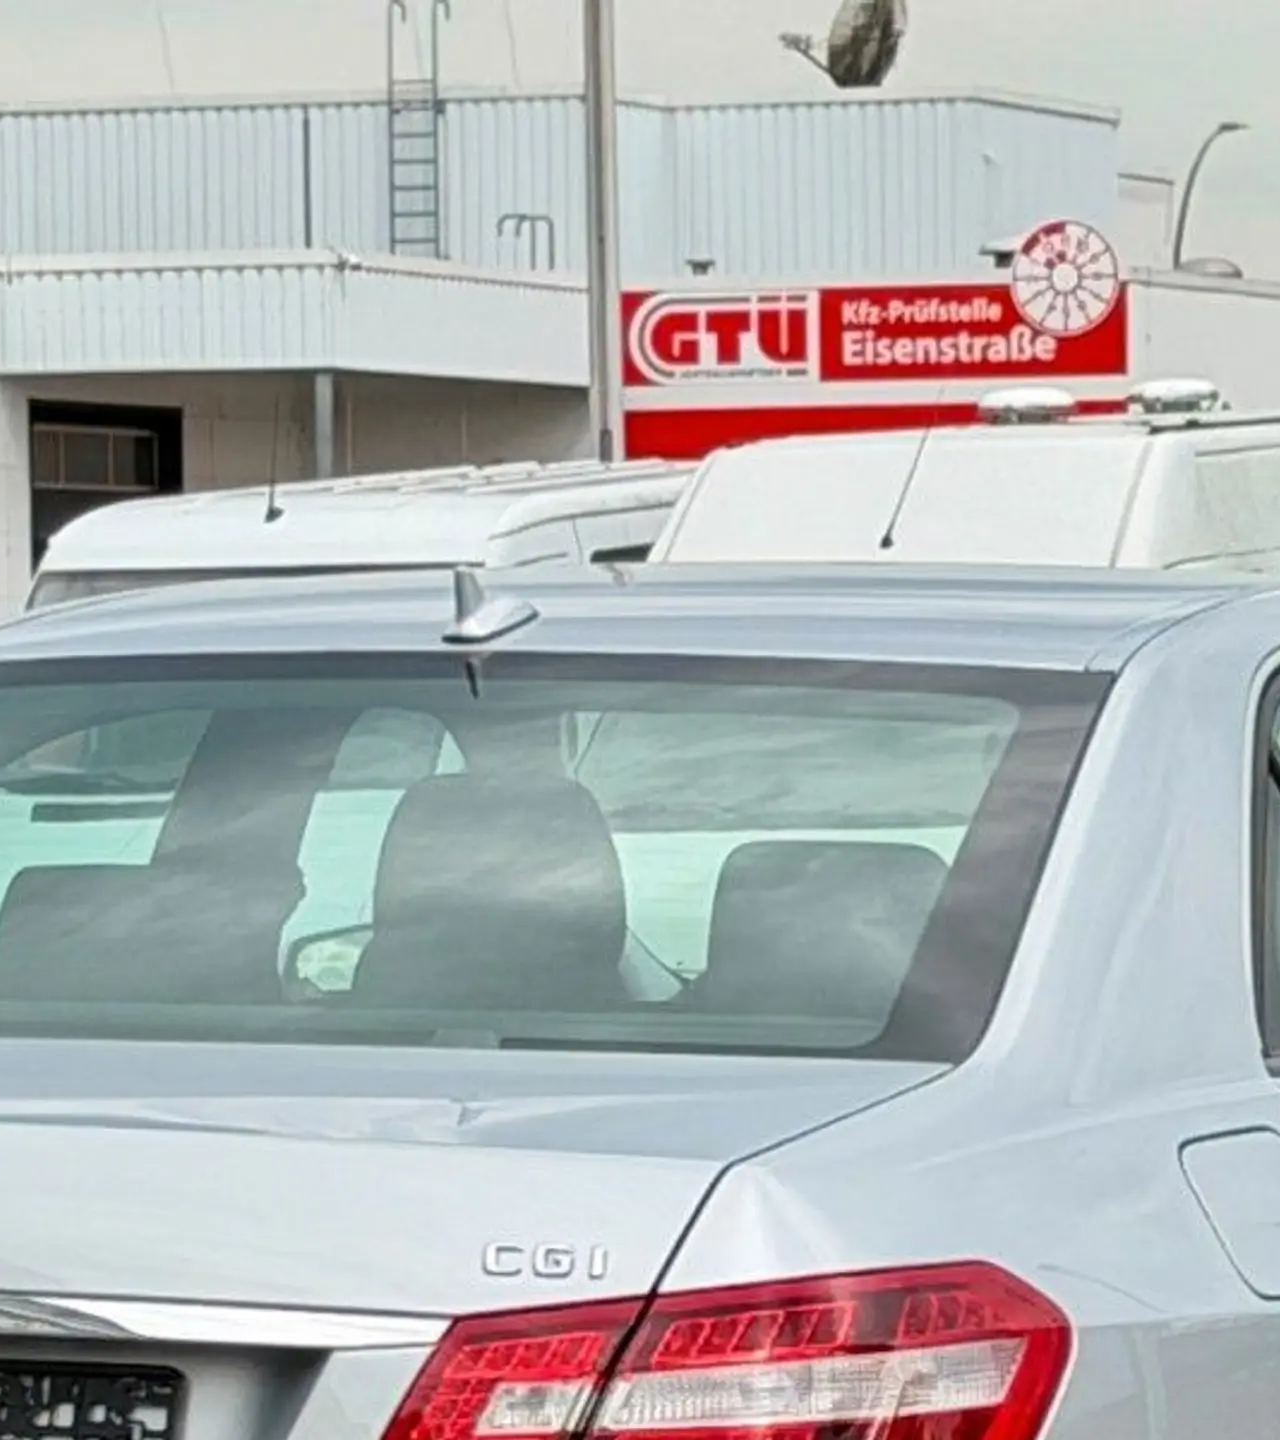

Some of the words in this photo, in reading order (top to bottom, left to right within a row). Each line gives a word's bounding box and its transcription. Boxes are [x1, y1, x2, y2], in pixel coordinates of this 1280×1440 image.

[650, 295, 807, 365] GTÜ
[841, 296, 1002, 324] Kfz-Prüfstelle
[841, 324, 1058, 366] Eisenstraße
[481, 1242, 609, 1280] CGI
